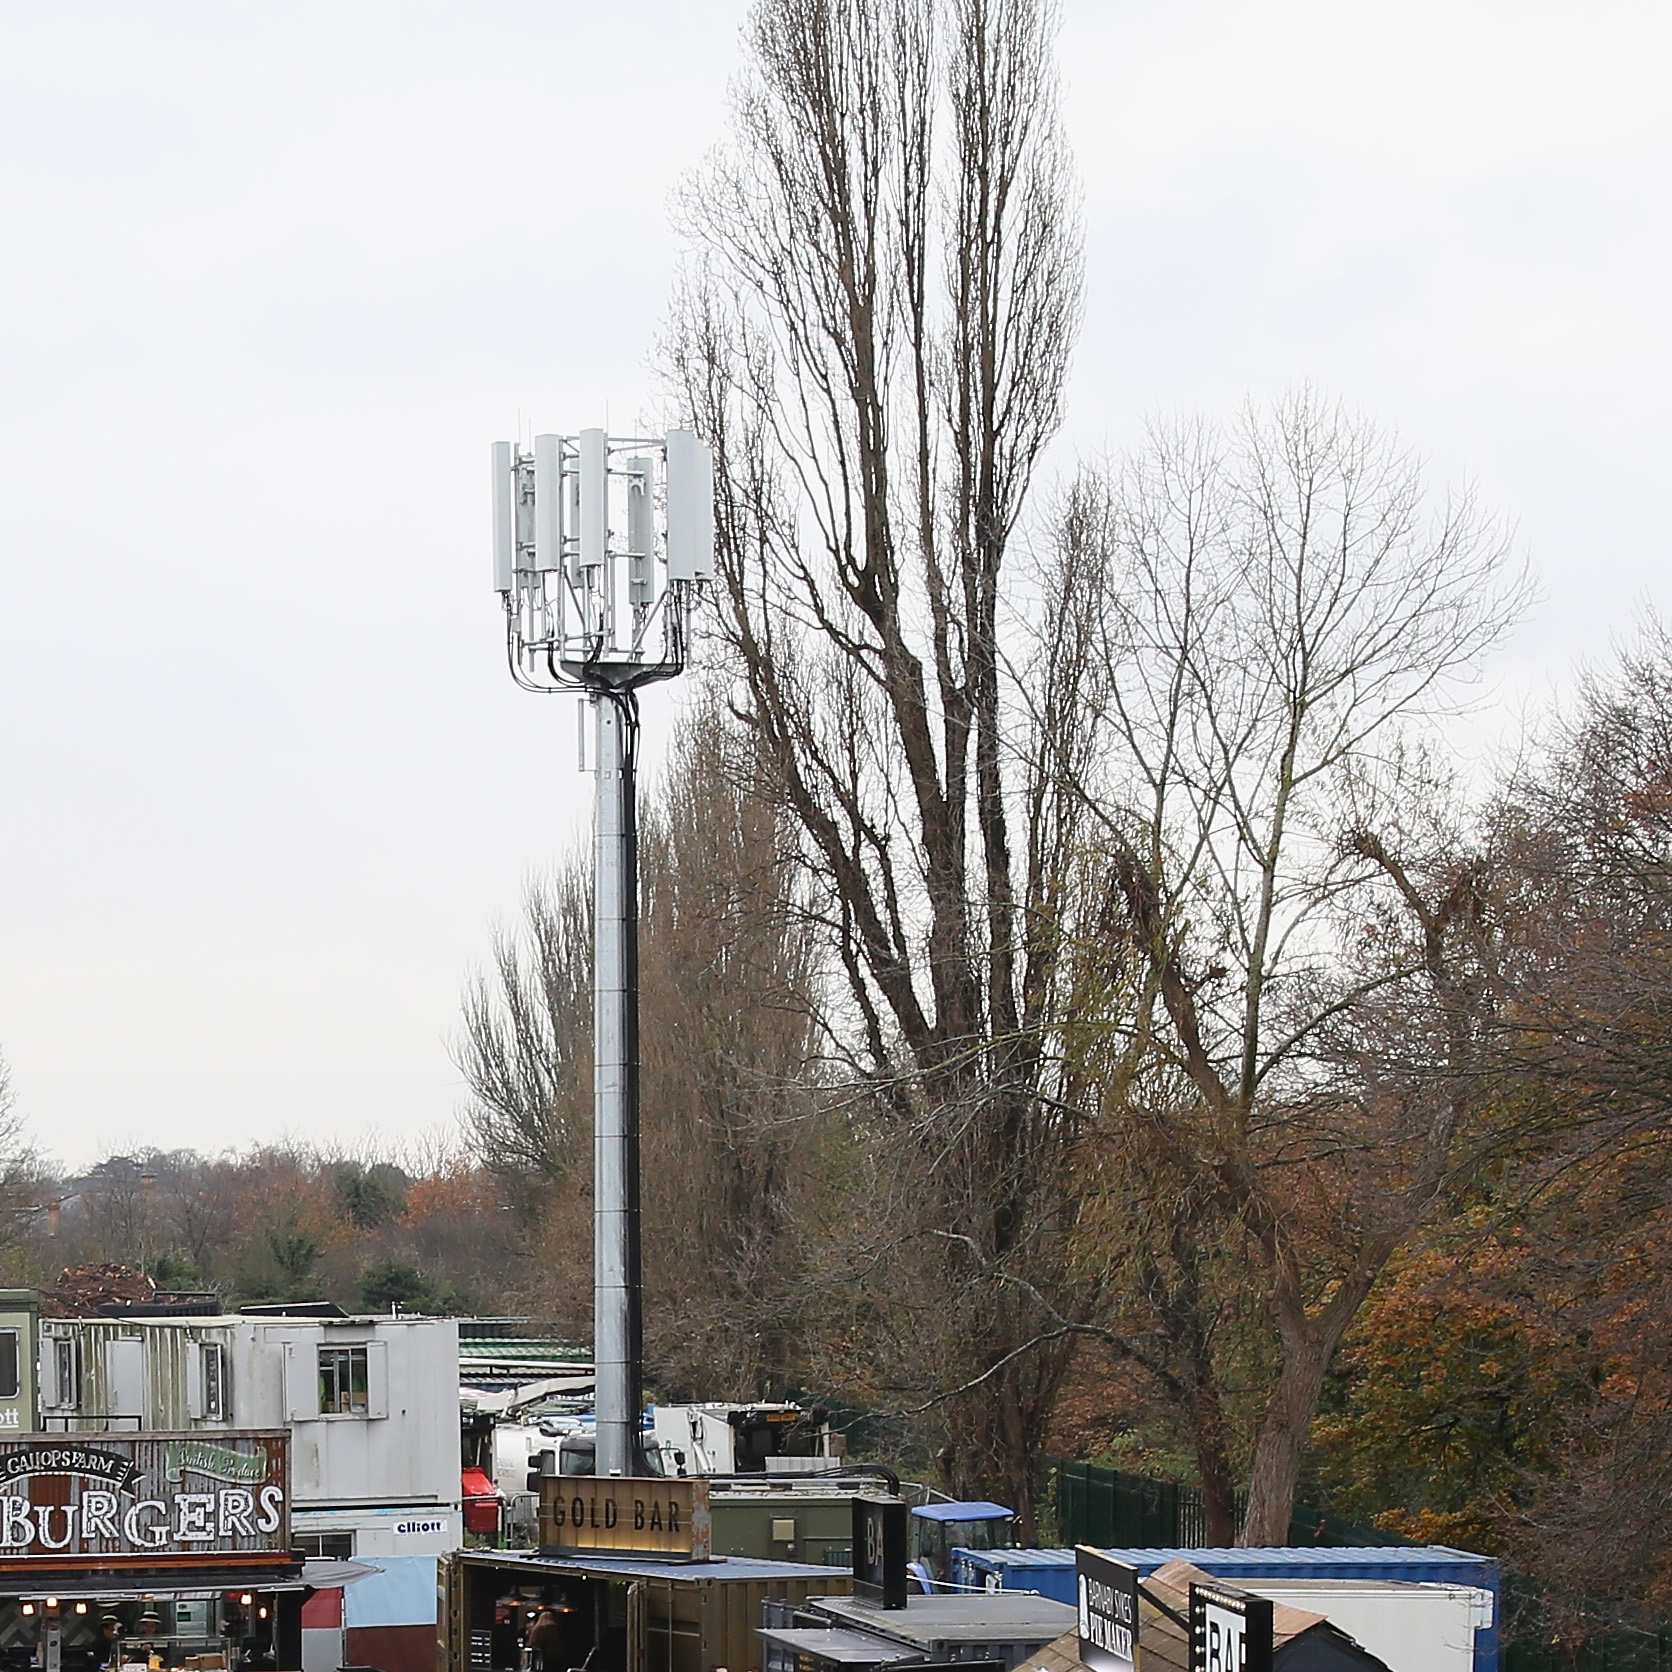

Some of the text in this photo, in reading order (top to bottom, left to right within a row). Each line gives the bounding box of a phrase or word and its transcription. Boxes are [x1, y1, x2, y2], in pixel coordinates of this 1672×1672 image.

[72, 1451, 115, 1473] FARM
[179, 1448, 261, 1478] British Produce
[553, 1496, 680, 1532] GOLD BAR
[867, 1516, 884, 1567] BA
[1090, 1611, 1133, 1663] PIE MAKER
